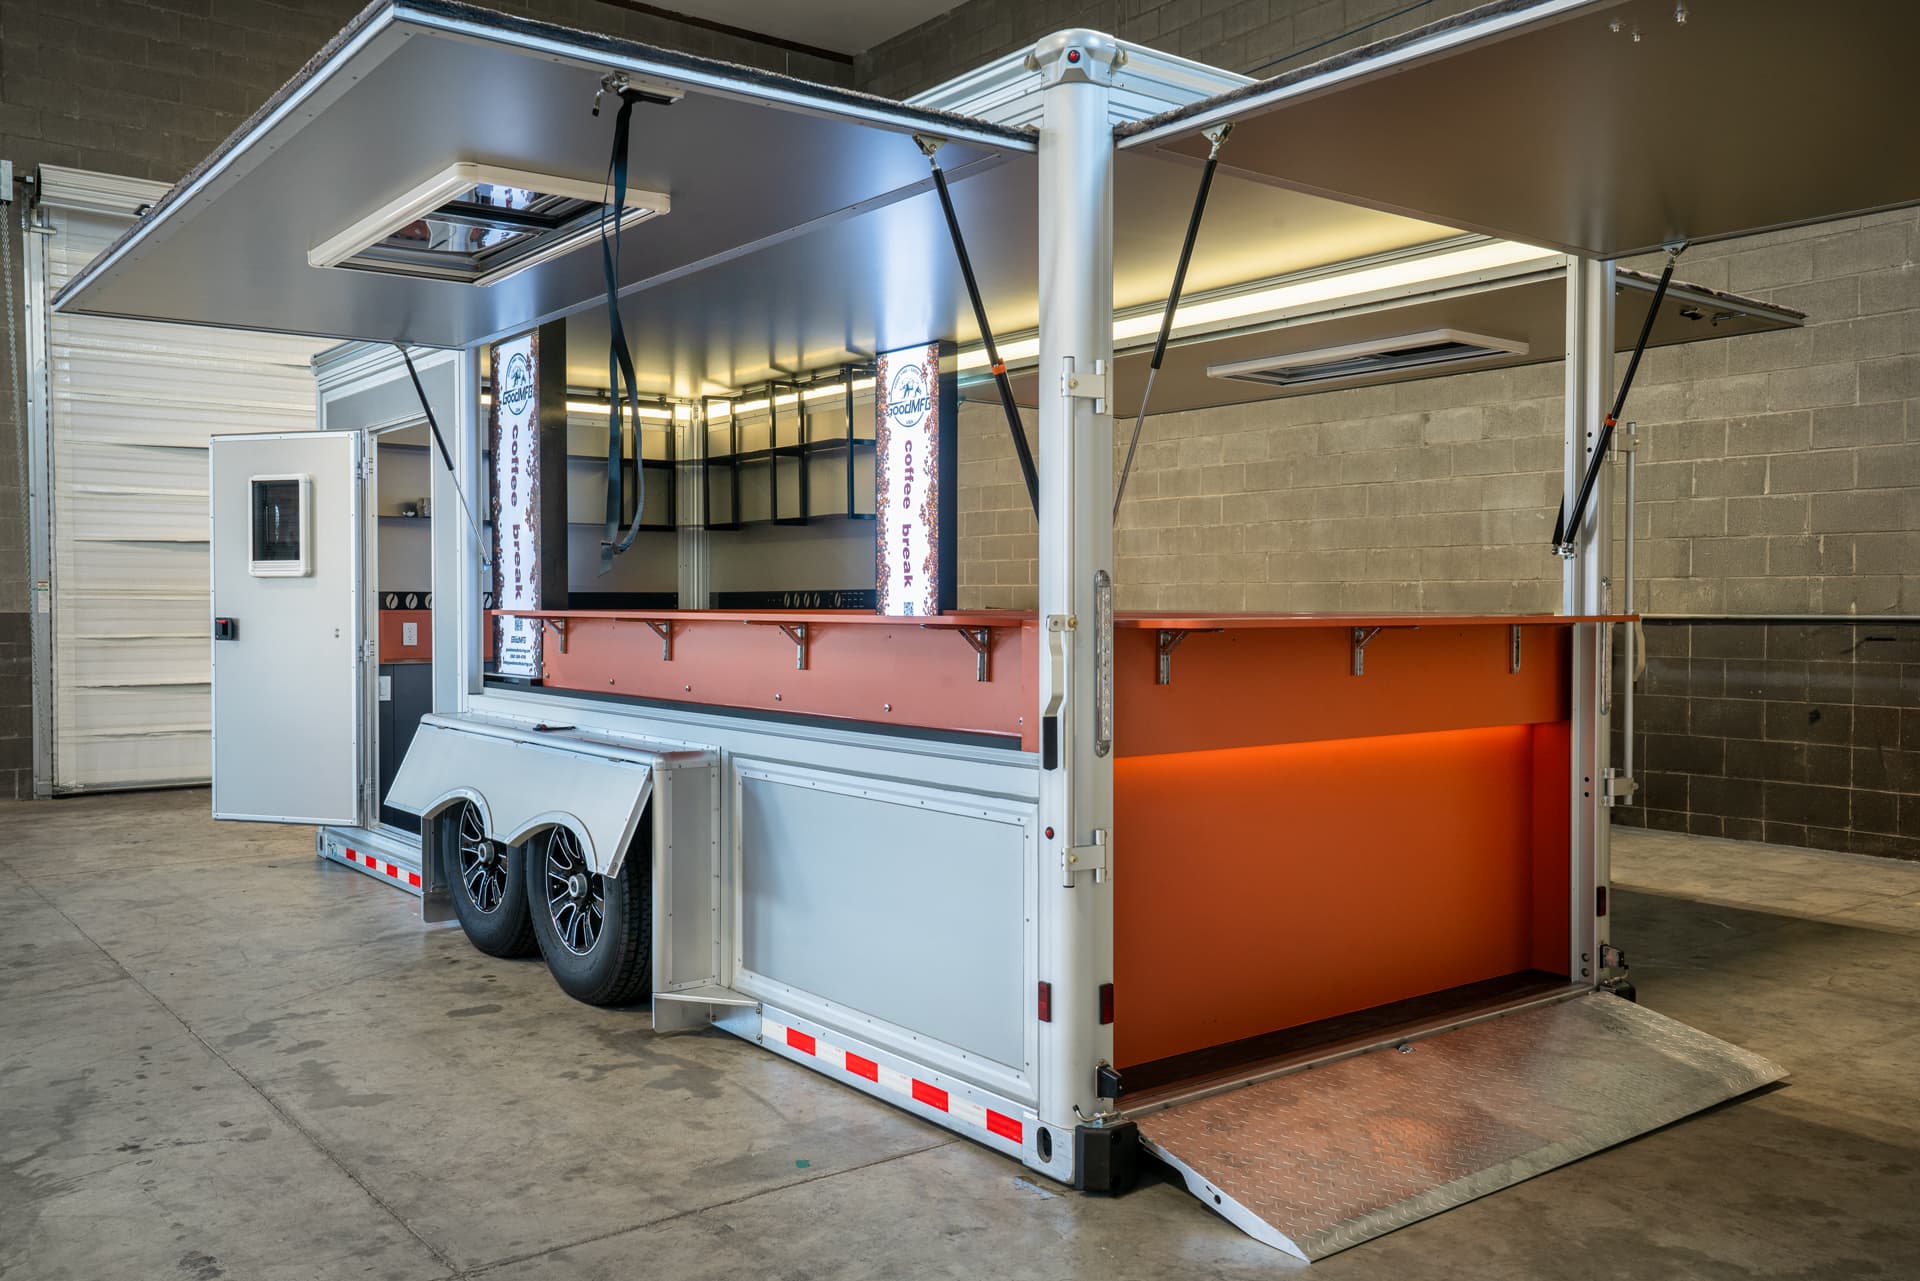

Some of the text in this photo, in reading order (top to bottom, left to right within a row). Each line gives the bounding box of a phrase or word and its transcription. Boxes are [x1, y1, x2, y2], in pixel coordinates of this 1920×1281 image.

[510, 424, 523, 600] coffee break
[902, 440, 914, 588] coffee break
